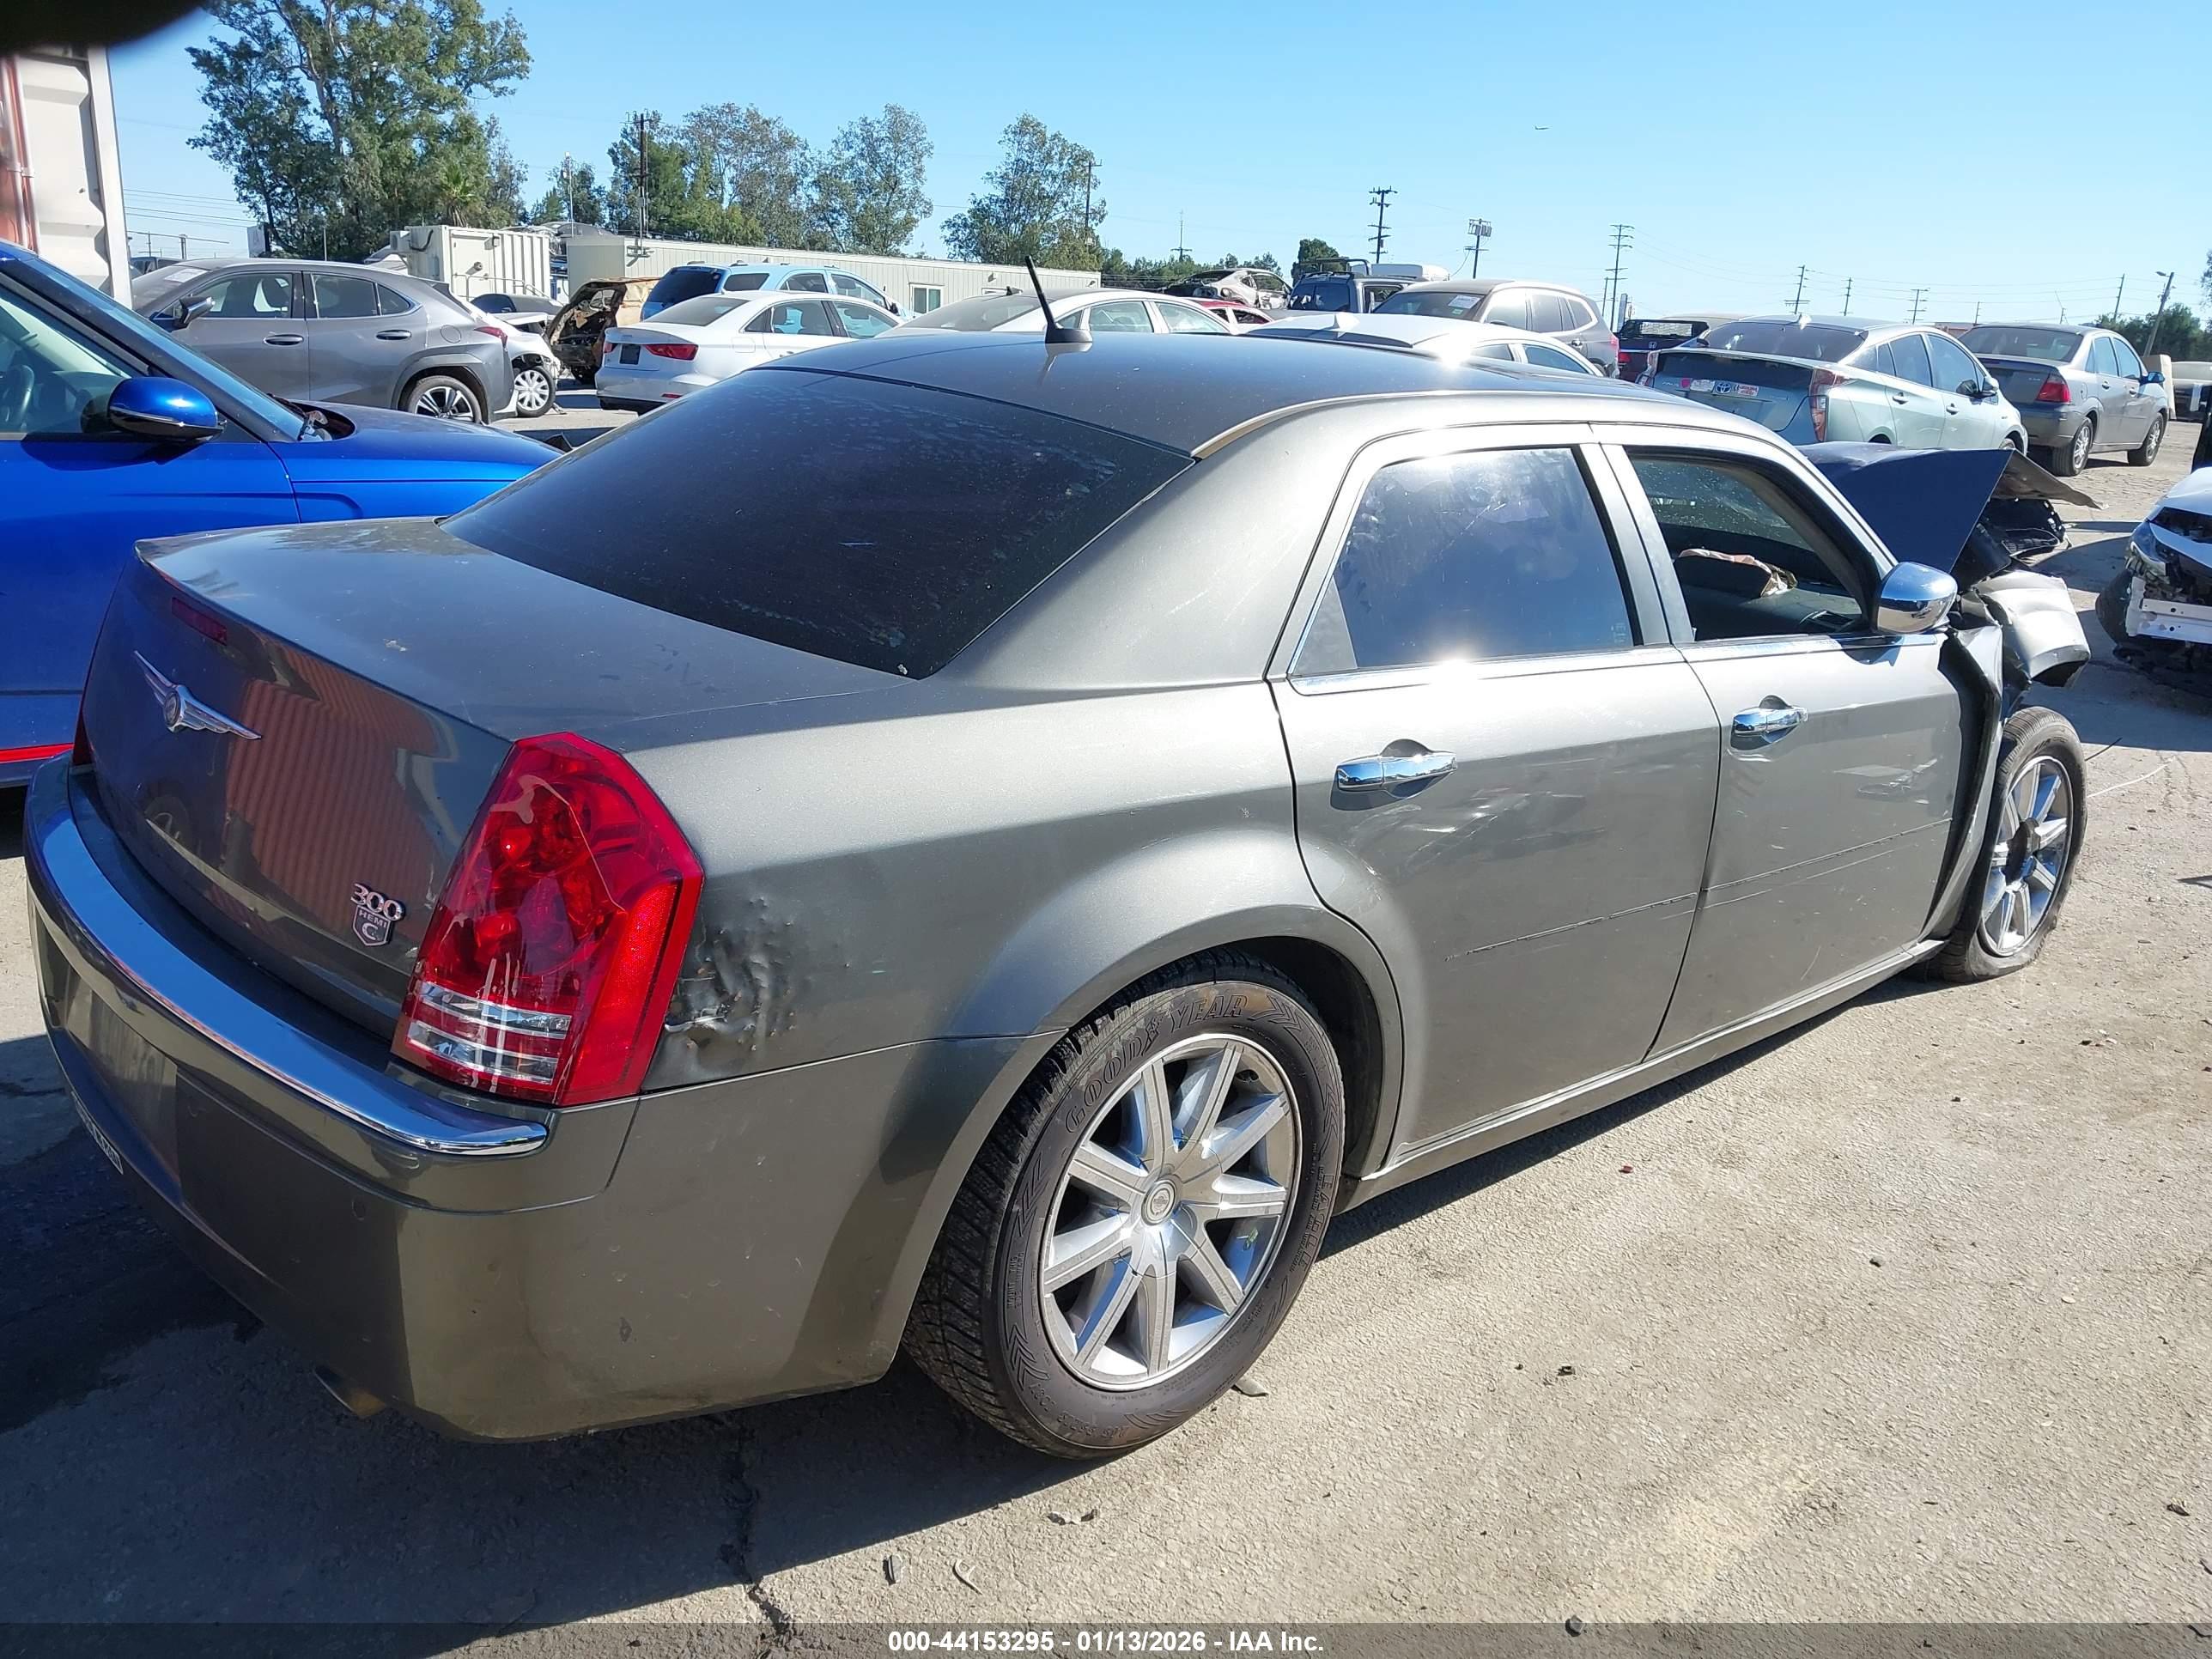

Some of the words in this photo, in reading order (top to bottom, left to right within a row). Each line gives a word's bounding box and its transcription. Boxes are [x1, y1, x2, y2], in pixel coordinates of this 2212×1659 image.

[350, 883, 403, 921] 300
[358, 909, 387, 928] HEMI
[362, 922, 379, 940] C
[1297, 1175, 1334, 1272] EAGLE
